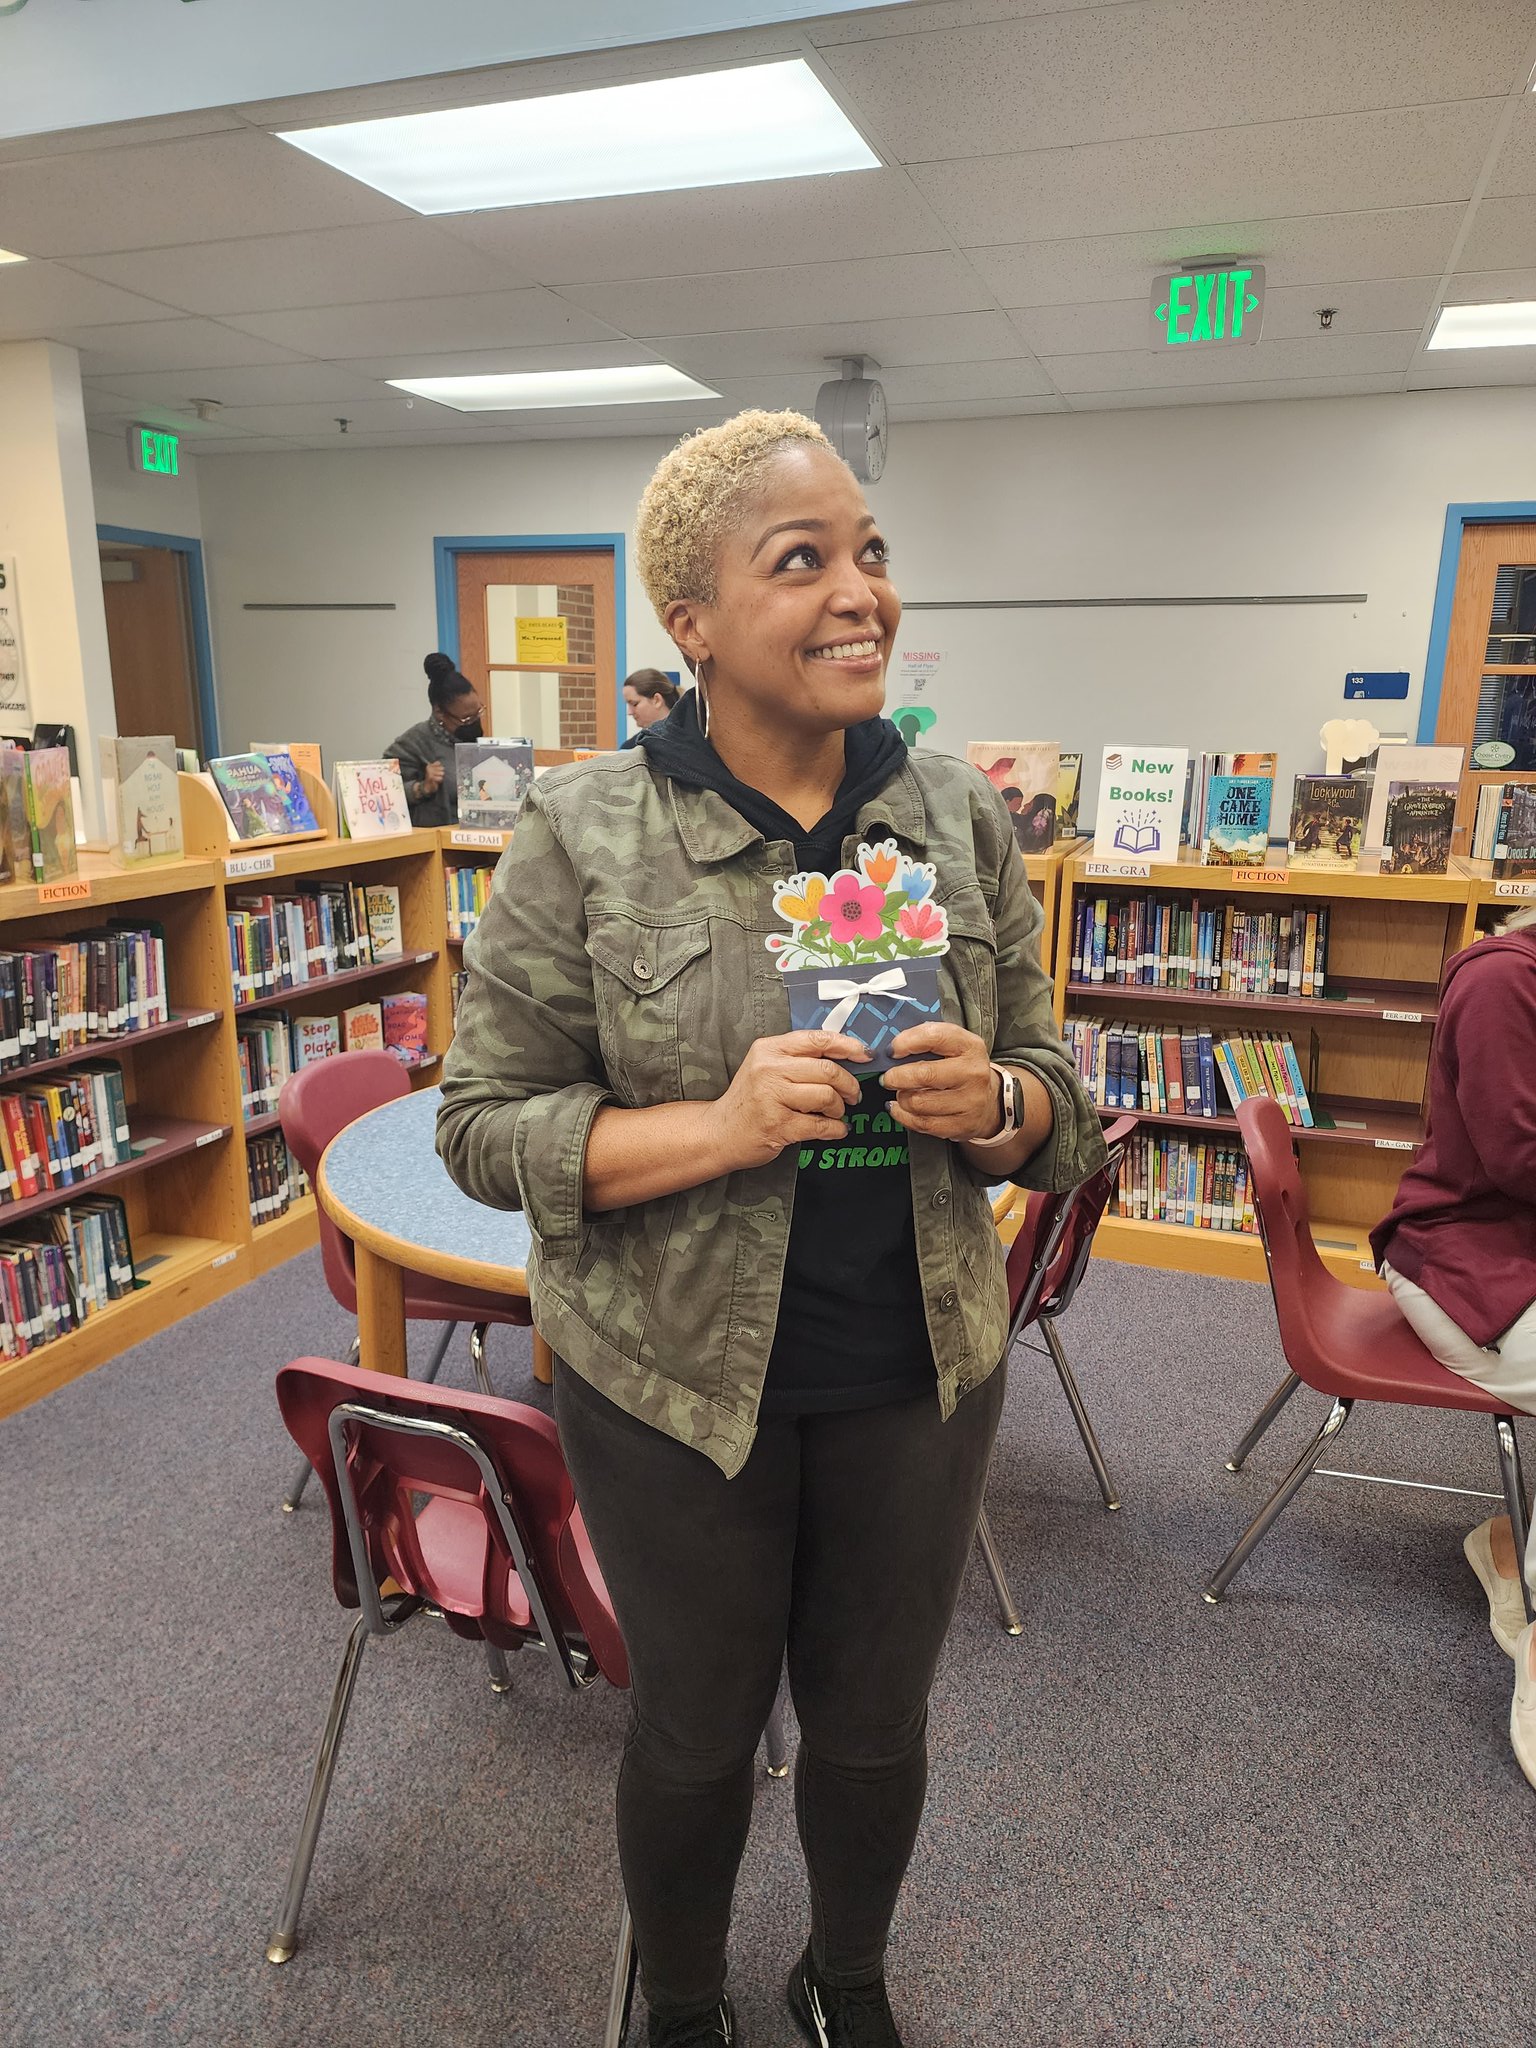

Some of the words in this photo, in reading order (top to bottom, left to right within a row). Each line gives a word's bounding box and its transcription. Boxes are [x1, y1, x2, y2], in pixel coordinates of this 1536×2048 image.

[1167, 269, 1252, 344] EXIT
[141, 430, 178, 475] EXIT
[903, 652, 940, 661] MISSING
[226, 764, 262, 778] PAHUA
[1131, 759, 1174, 774] New
[1109, 786, 1174, 803] Books!
[1227, 786, 1257, 799] ONE
[1311, 782, 1356, 801] Lockwood
[1220, 800, 1261, 812] CAME
[1218, 813, 1260, 826] HOME
[455, 833, 472, 843] CLE
[478, 836, 500, 845] DAH
[229, 860, 247, 873] BLU
[253, 859, 272, 872] CHR
[1088, 864, 1110, 874] FER
[1120, 866, 1147, 876] GRA
[1236, 871, 1286, 882] FICTION
[43, 884, 88, 899] FICTION
[1499, 884, 1530, 895] GRE
[1385, 1012, 1398, 1020] FER
[1404, 1013, 1419, 1021] FOX
